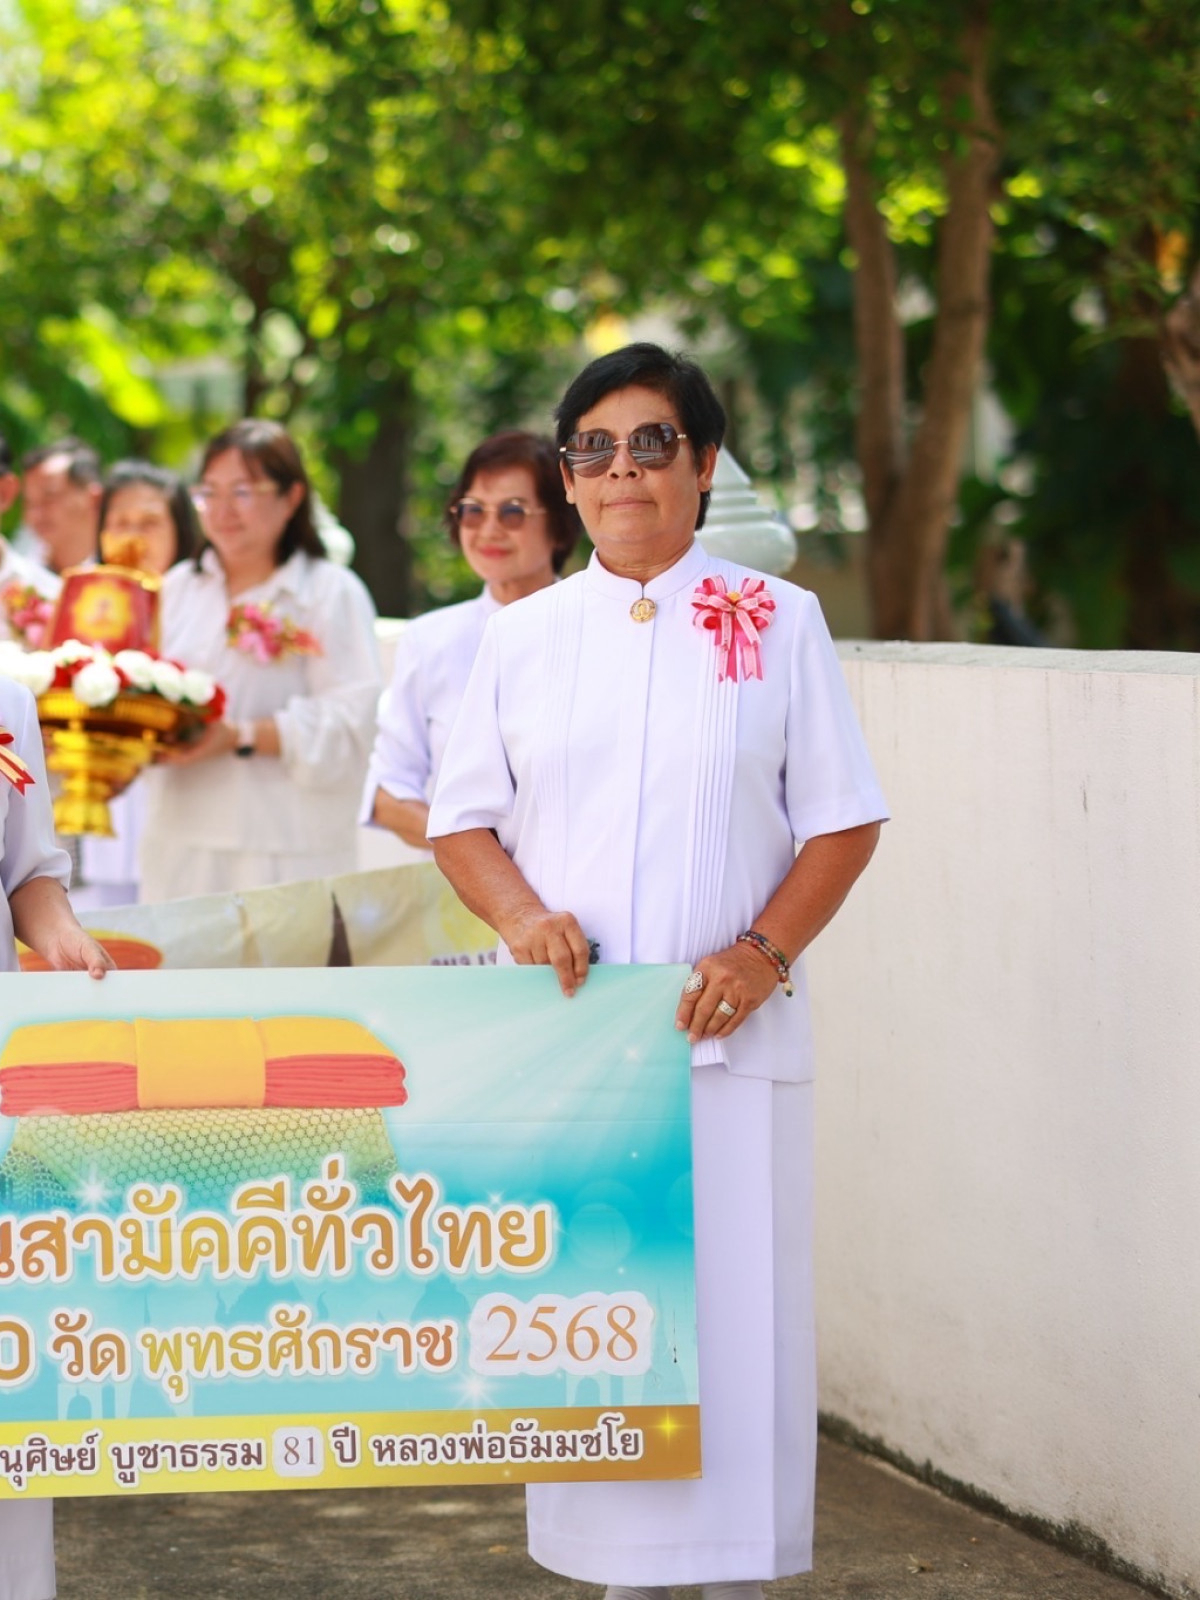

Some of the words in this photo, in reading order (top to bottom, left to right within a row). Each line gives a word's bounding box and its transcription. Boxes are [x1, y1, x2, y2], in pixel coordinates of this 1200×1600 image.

[52, 1312, 126, 1377] วัด
[141, 1309, 453, 1397] พุทธศักราช
[485, 1304, 639, 1362] 2568
[112, 1438, 263, 1483] บูชาธรรม
[283, 1435, 317, 1466] 81
[334, 1427, 357, 1465] ปี
[371, 1415, 641, 1464] หลวงพ่อธัมมชโย
